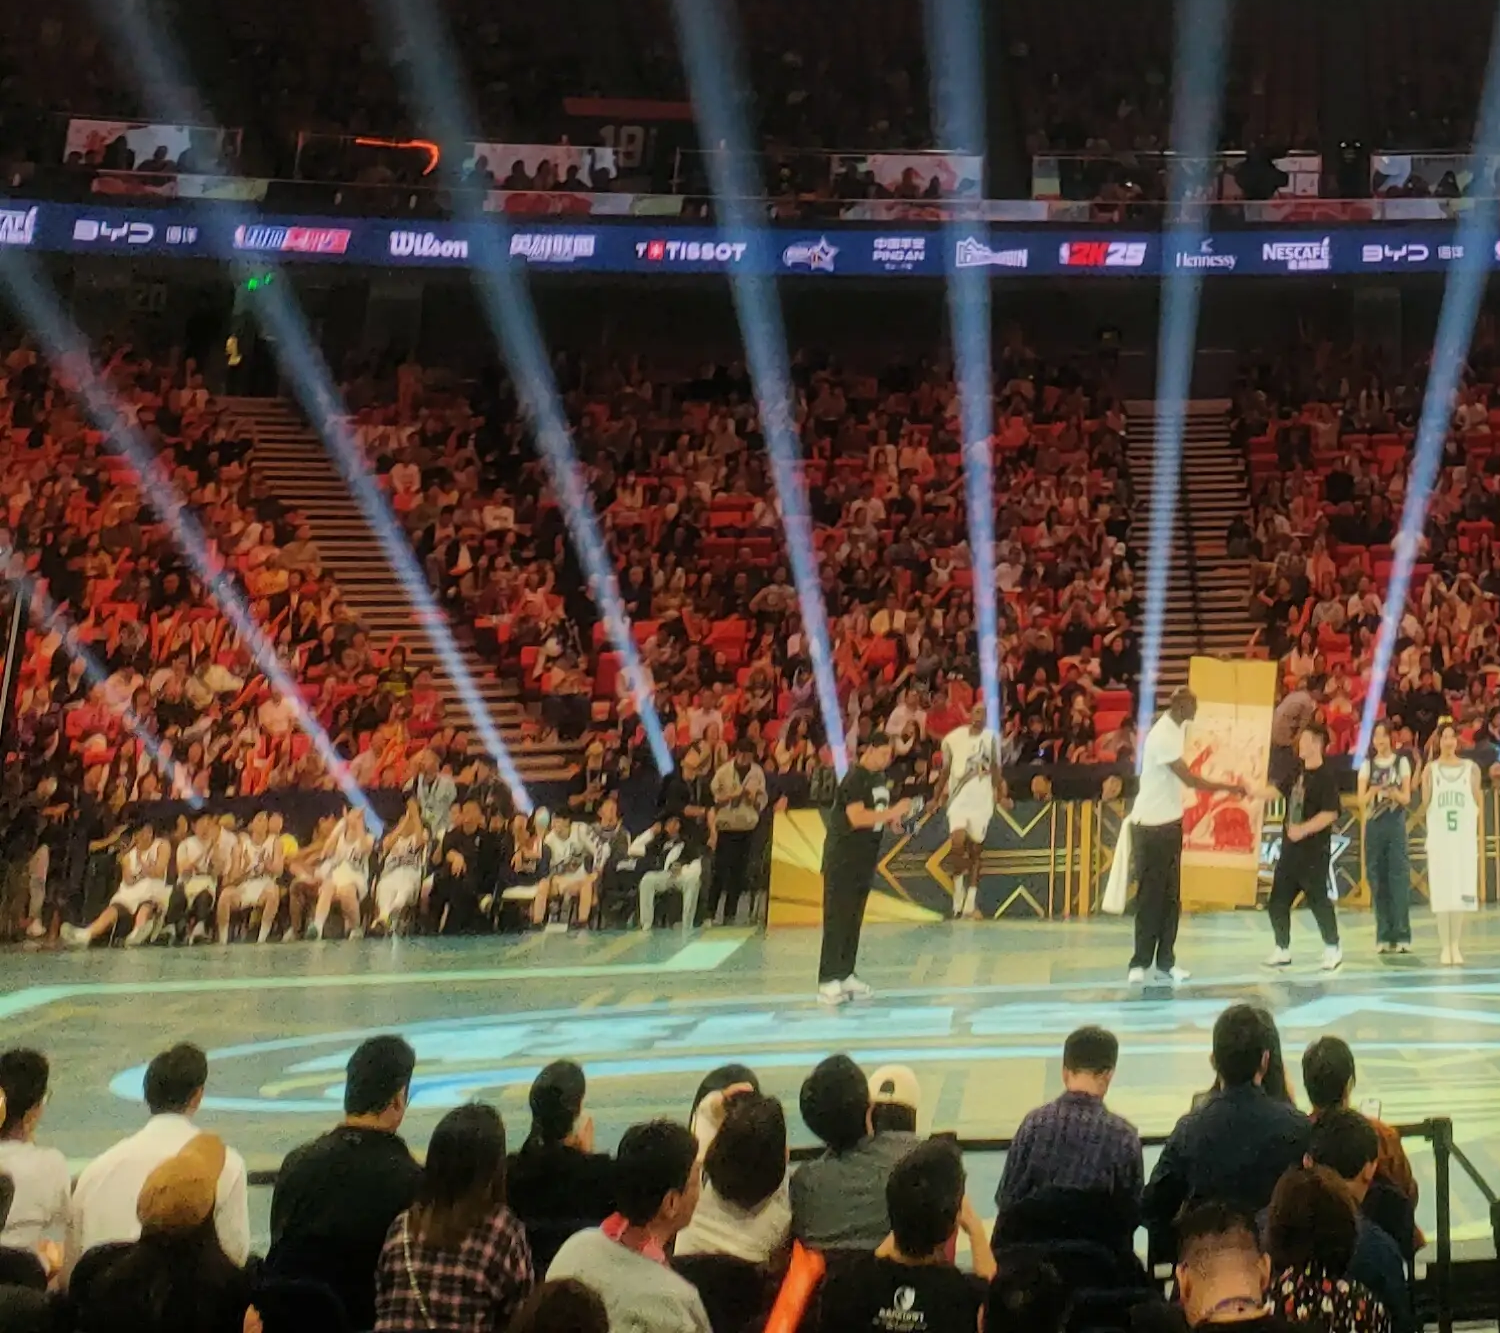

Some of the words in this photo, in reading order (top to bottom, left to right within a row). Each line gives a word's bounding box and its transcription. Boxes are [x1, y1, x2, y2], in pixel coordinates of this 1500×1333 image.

[390, 231, 468, 259] Wilson
[666, 241, 747, 262] TISSOT
[1069, 242, 1148, 267] 2K25
[1362, 244, 1430, 263] BYD
[1176, 252, 1239, 271] Hennessy
[1446, 810, 1458, 832] 5
